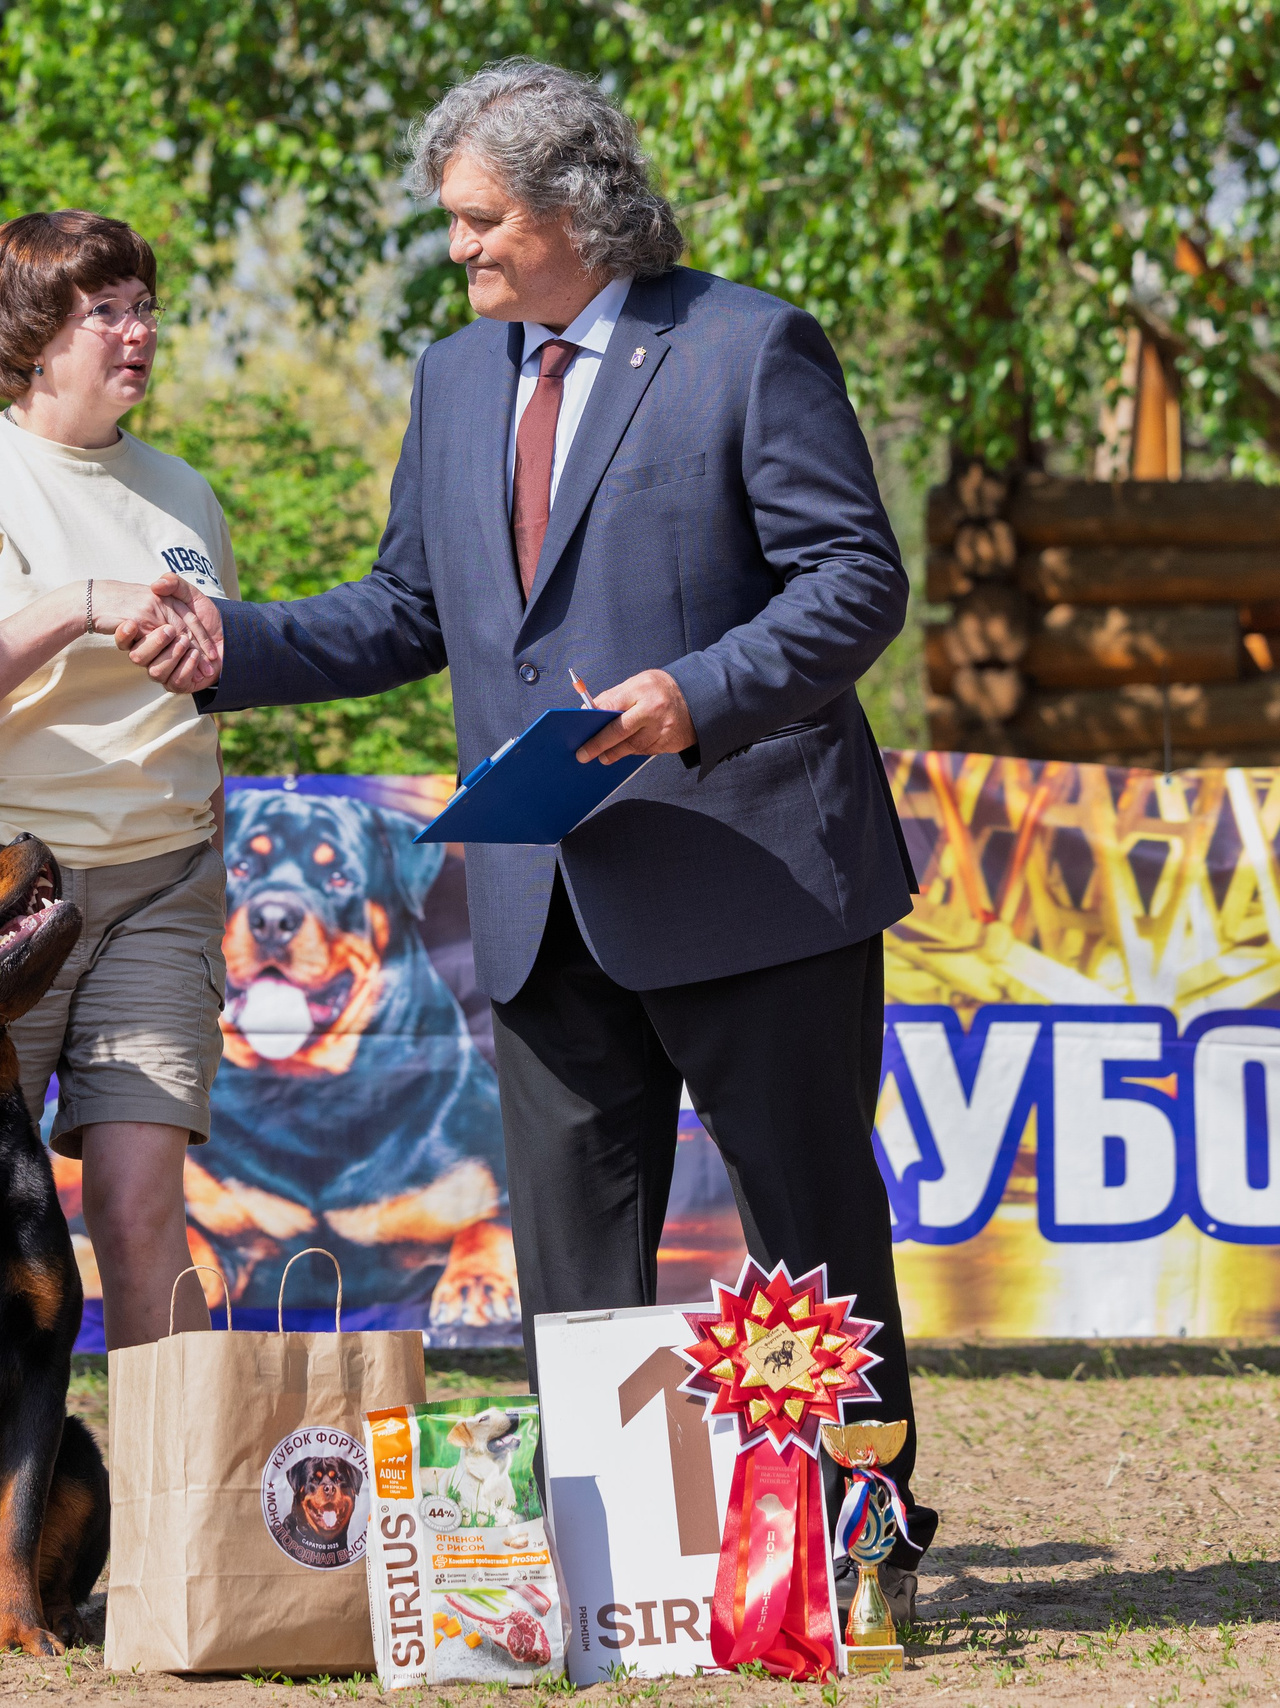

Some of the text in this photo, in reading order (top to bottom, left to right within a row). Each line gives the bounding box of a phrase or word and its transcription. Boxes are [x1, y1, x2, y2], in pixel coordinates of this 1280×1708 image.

[884, 1020, 1280, 1229] УБО
[272, 1431, 369, 1480] КУБОК ФОРТУН
[380, 1468, 407, 1480] ADULT
[618, 1345, 720, 1557] 1
[266, 1491, 336, 1565] МОНОПОРОДНАЯ
[428, 1508, 455, 1519] 44%
[301, 1538, 327, 1550] САРАТОВ
[435, 1534, 483, 1543] ЯГНЕНОК
[436, 1543, 485, 1552] С РИСОМ
[381, 1513, 426, 1667] SIRIUS
[756, 1530, 776, 1633] ПОБИТЕЛЬ
[578, 1606, 591, 1652] PREMIUM
